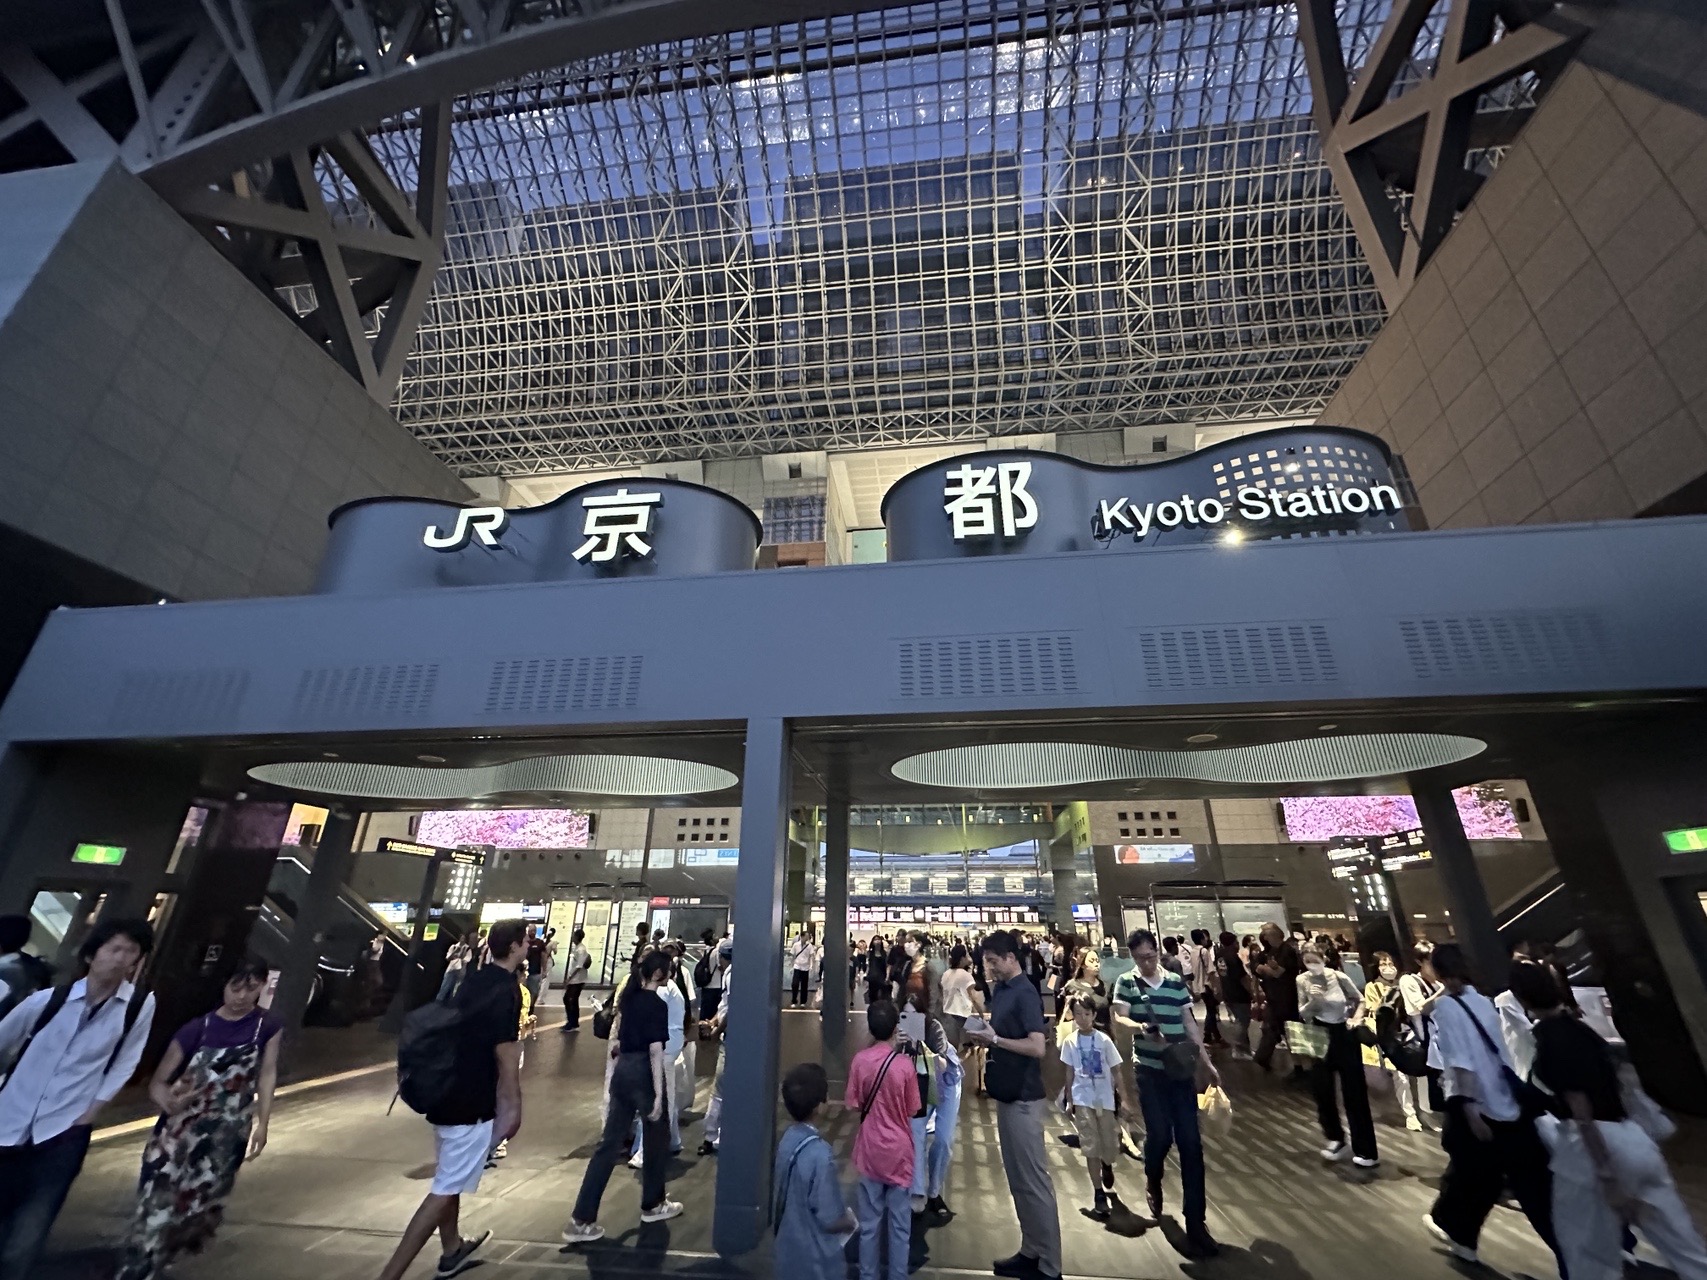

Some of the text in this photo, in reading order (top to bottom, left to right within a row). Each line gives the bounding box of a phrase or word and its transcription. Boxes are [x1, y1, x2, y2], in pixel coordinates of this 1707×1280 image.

[423, 506, 505, 549] JR
[571, 489, 662, 562] 京
[943, 461, 1039, 539] 都
[1100, 483, 1402, 538] Kyoto Station
